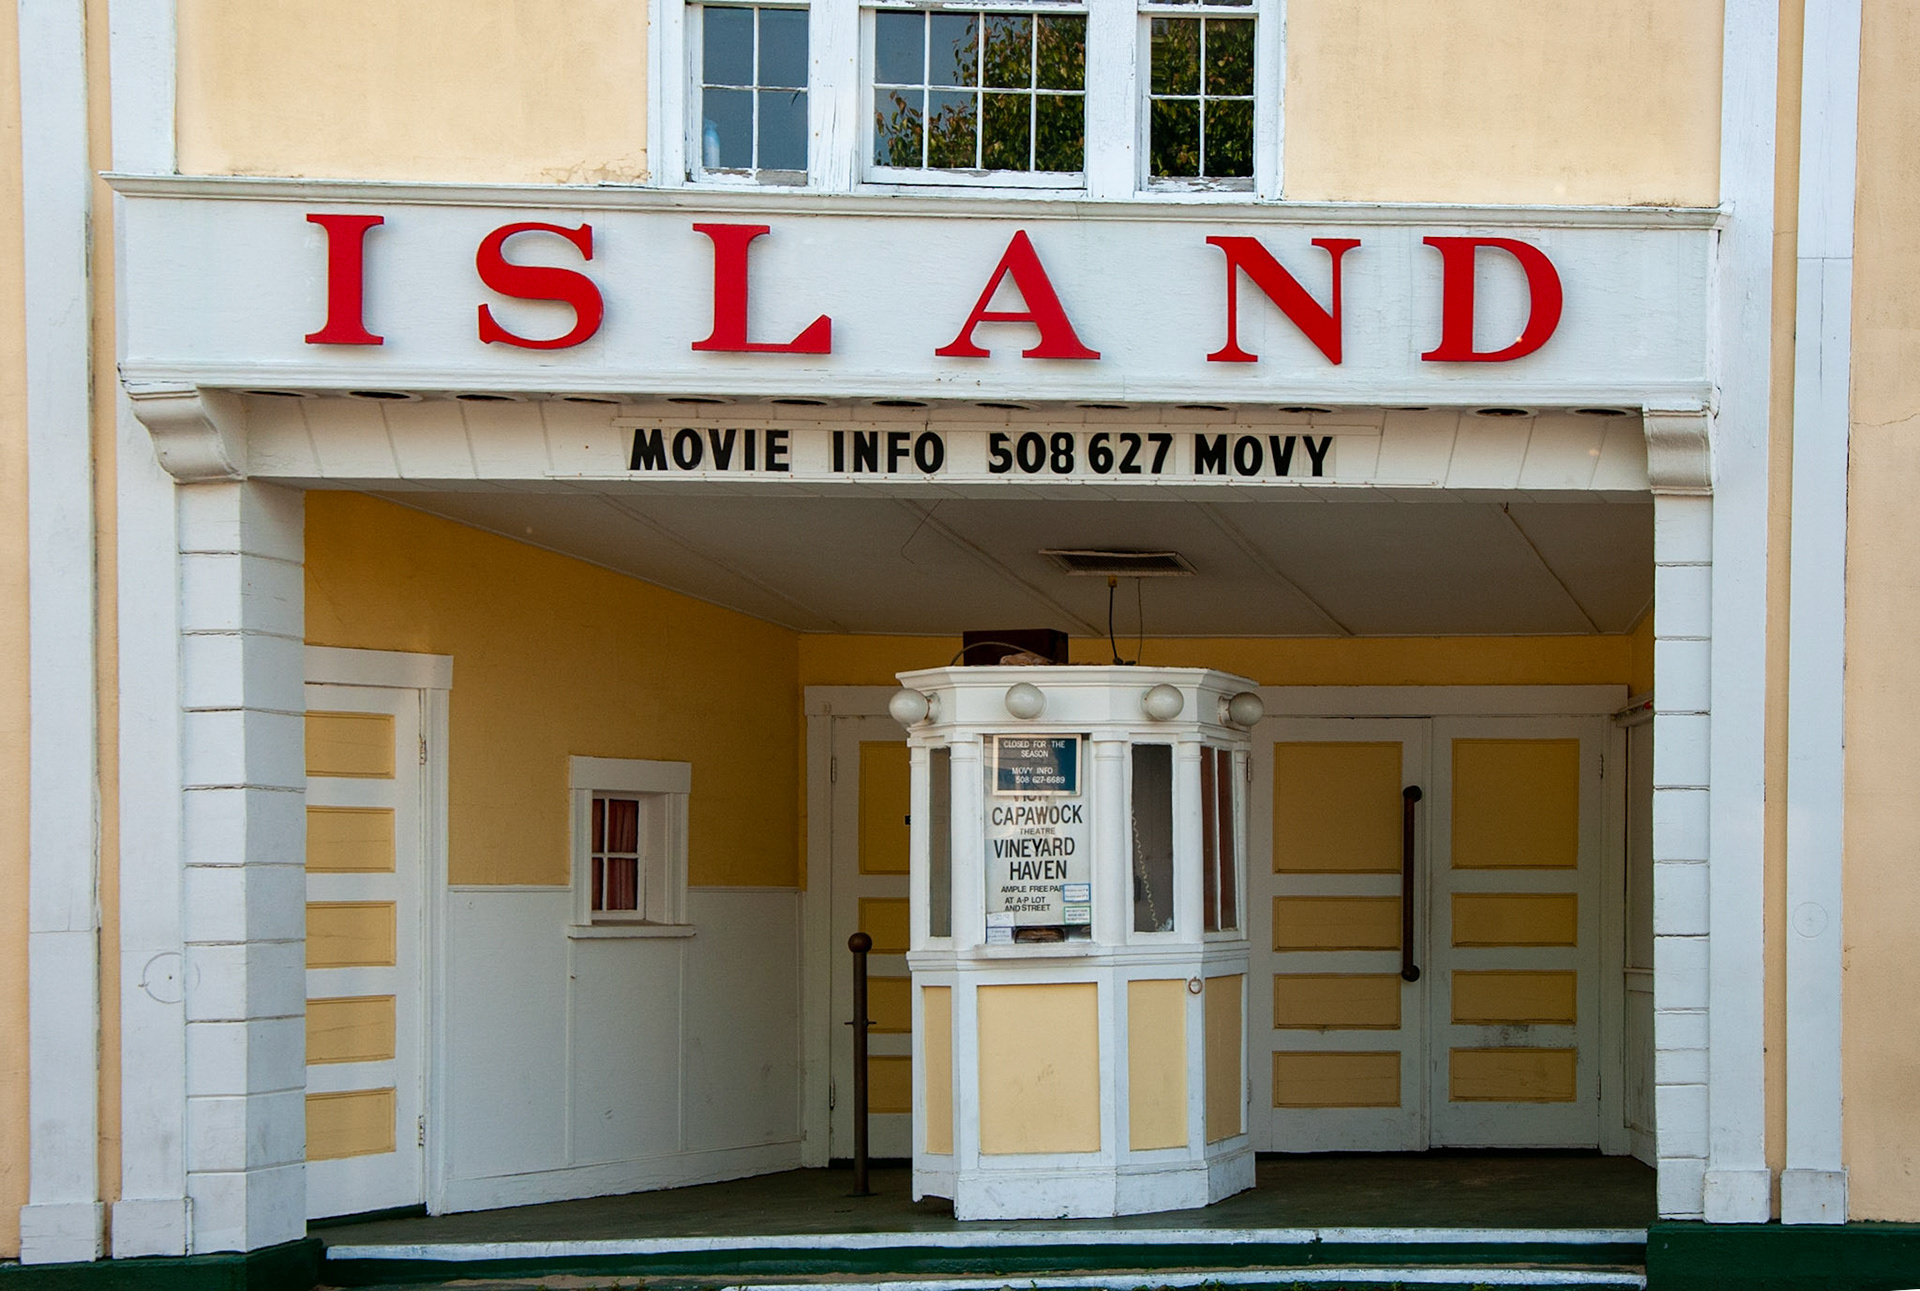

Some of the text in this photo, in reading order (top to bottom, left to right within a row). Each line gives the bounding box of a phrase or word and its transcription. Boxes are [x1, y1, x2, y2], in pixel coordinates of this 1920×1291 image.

[305, 214, 1562, 365] ISLAND
[629, 429, 1333, 477] MOVIE INFO 508 627 MOVY
[1003, 740, 1066, 748] CLOSED FOR THE
[1020, 750, 1049, 758] SEASON
[1011, 767, 1053, 775] MOVY INFO
[1015, 776, 1030, 784] 508
[992, 804, 1083, 826] CAPAWOCK
[1020, 827, 1056, 836] THEATRE
[993, 837, 1076, 859] VINEYARD
[1009, 860, 1067, 881] HAVEN
[1000, 885, 1027, 893] AMPLE
[1029, 885, 1048, 893] FREE
[1004, 896, 1046, 904] AT A-P LOT
[1004, 904, 1051, 912] AND STREET
